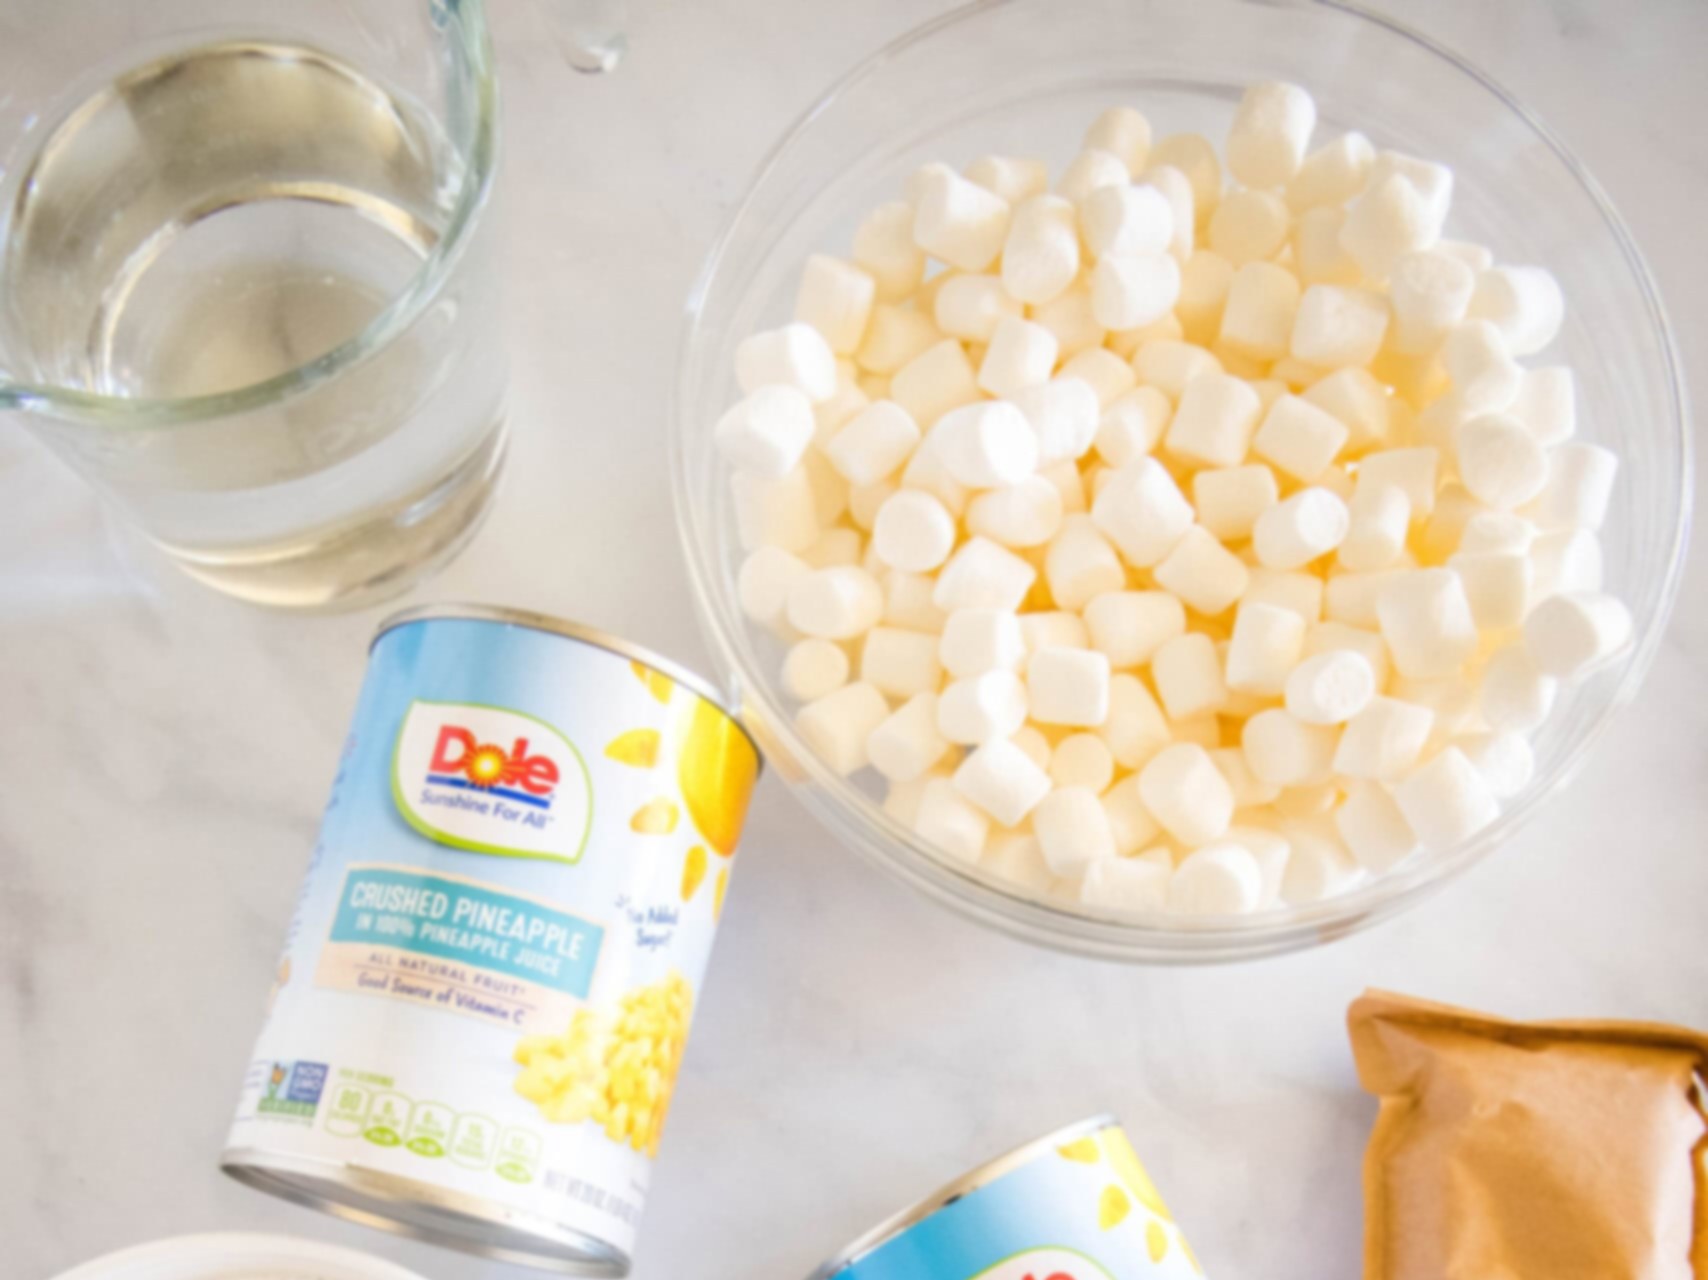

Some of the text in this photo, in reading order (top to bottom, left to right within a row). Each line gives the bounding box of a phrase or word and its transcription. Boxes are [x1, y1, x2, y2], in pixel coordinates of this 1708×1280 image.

[428, 724, 560, 795] Dole
[420, 788, 490, 815] Sunshine
[492, 801, 521, 823] For
[349, 880, 586, 961] CRUSHED PINEAPPLE
[355, 912, 374, 932] IN
[419, 921, 512, 961] PINEAPPLE
[513, 945, 563, 978] JUICE
[398, 956, 467, 984] NATURAL
[455, 992, 510, 1020] Vitamin
[512, 1007, 527, 1026] C
